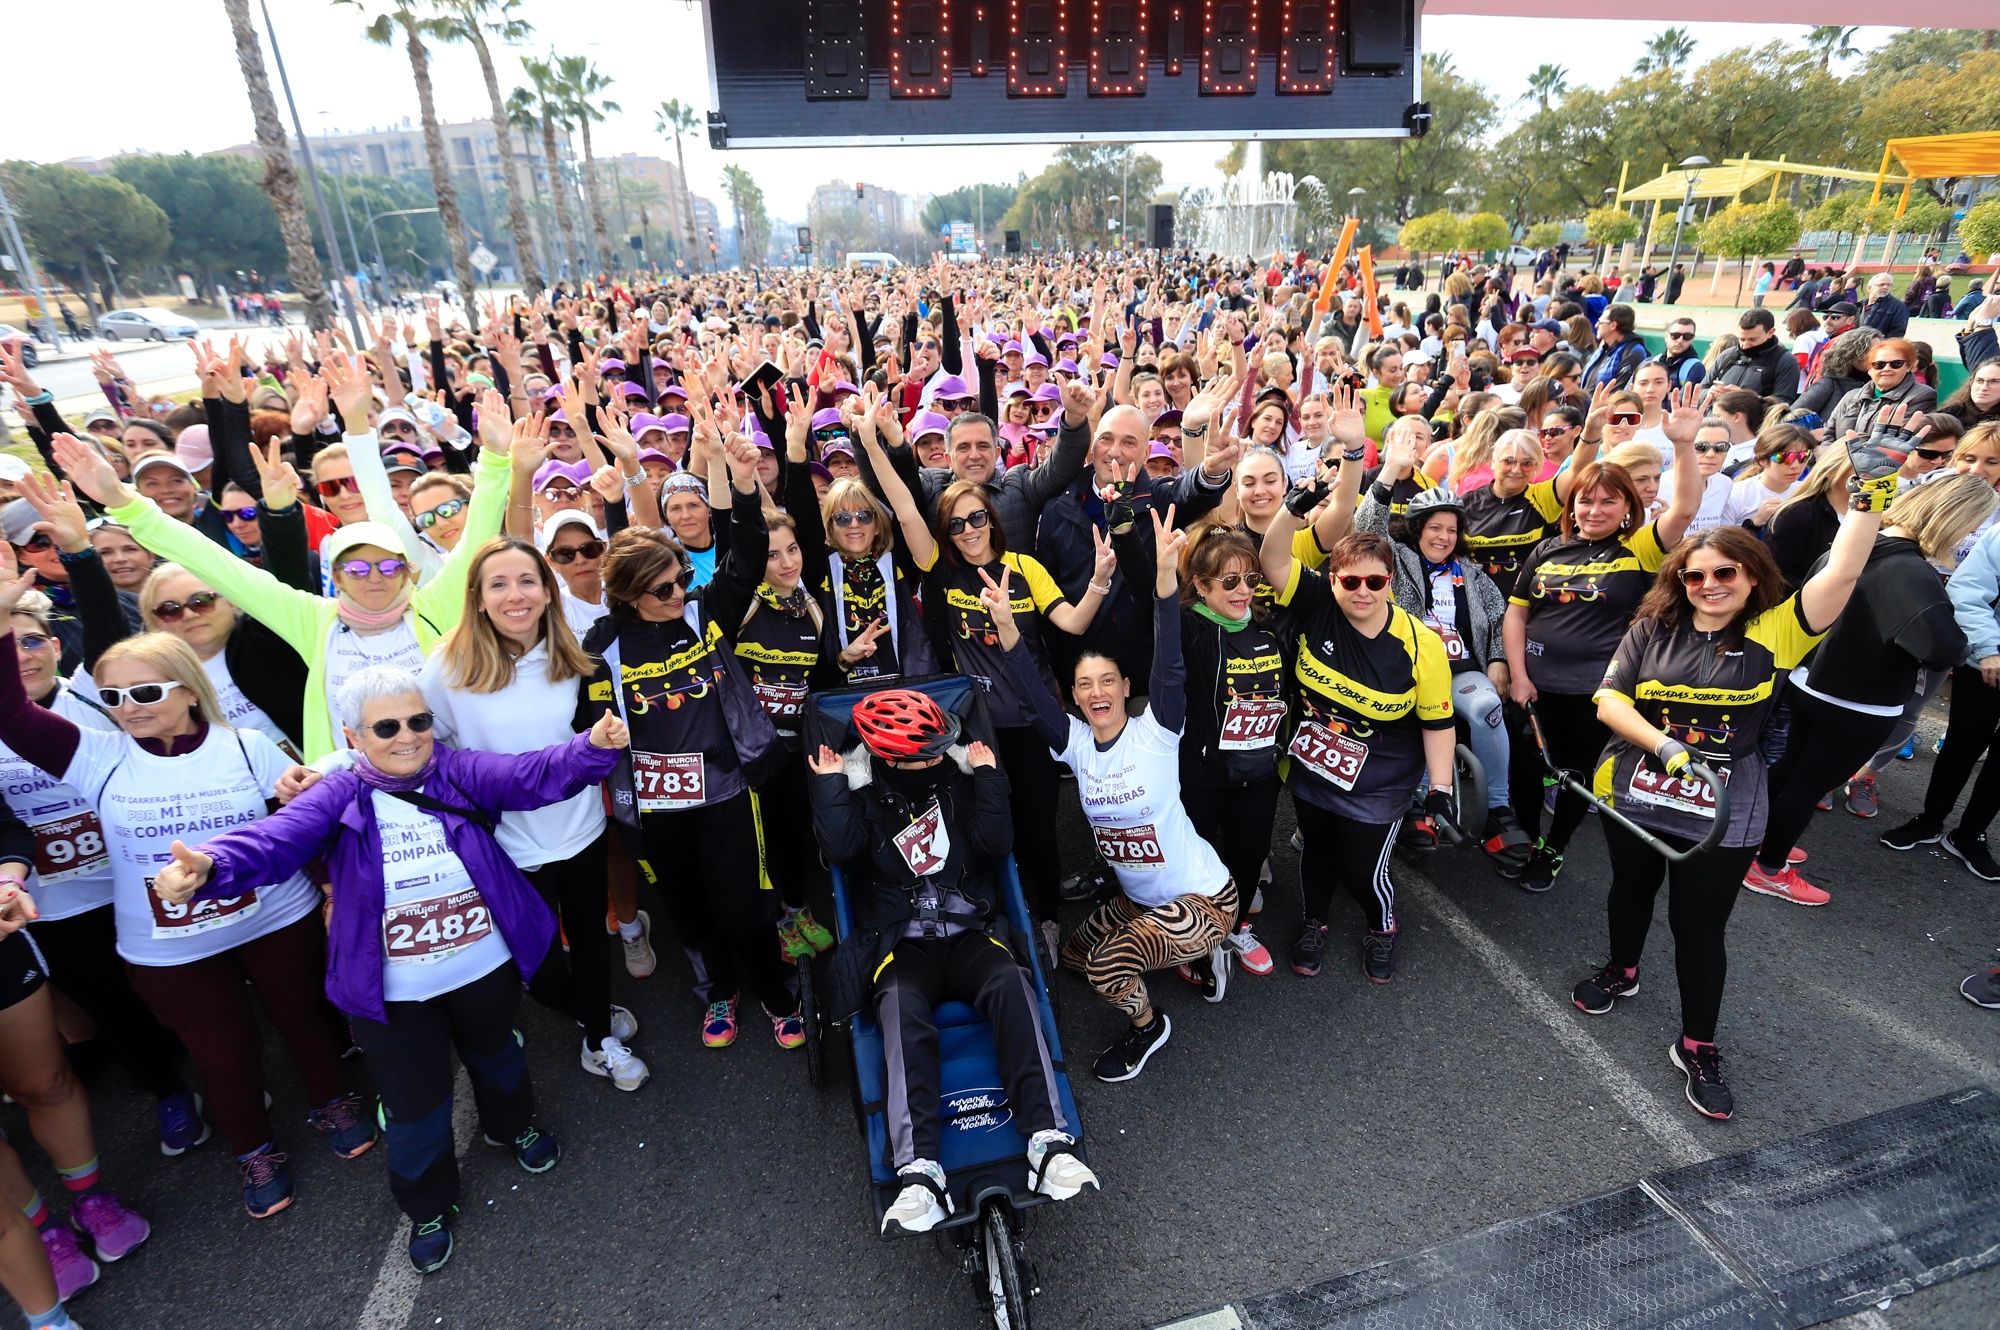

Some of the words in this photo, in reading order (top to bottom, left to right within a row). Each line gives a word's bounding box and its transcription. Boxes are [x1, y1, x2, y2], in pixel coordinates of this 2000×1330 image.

[1328, 683, 1369, 705] SOBRE
[1371, 698, 1412, 713] RUEDAS
[1644, 689, 1688, 698] ZANCADAS
[1688, 692, 1725, 701] SOBRE
[1726, 691, 1759, 701] RUEDAS
[1225, 713, 1281, 735] 4787
[1310, 726, 1333, 741] mujer
[1336, 737, 1364, 753] MURCIA
[640, 756, 662, 770] mujer
[667, 756, 699, 764] MURCIA
[1295, 734, 1359, 776] 4793
[633, 769, 701, 794] 4783
[127, 796, 168, 804] CARRERA
[169, 793, 182, 802] DE
[184, 792, 197, 800] LA
[199, 788, 229, 798] MUJER
[1084, 785, 1146, 806] OMPAÑERAS
[1675, 795, 1696, 804] JESUS
[127, 809, 158, 822] POR
[161, 801, 183, 819] MÍ
[187, 804, 199, 816] Y
[201, 799, 234, 815] POR
[134, 809, 256, 839] COMPAÑERAS
[417, 820, 428, 829] LA
[1125, 826, 1153, 835] MURCIA
[910, 832, 933, 867] 47
[1099, 839, 1160, 858] 3780
[405, 903, 440, 919] mujer
[388, 906, 489, 950] 2482
[428, 942, 457, 953] CHISPA
[948, 1094, 989, 1107] Advance
[957, 1099, 995, 1113] Mobility
[951, 1113, 990, 1126] Advance
[959, 1117, 997, 1131] Mobility
